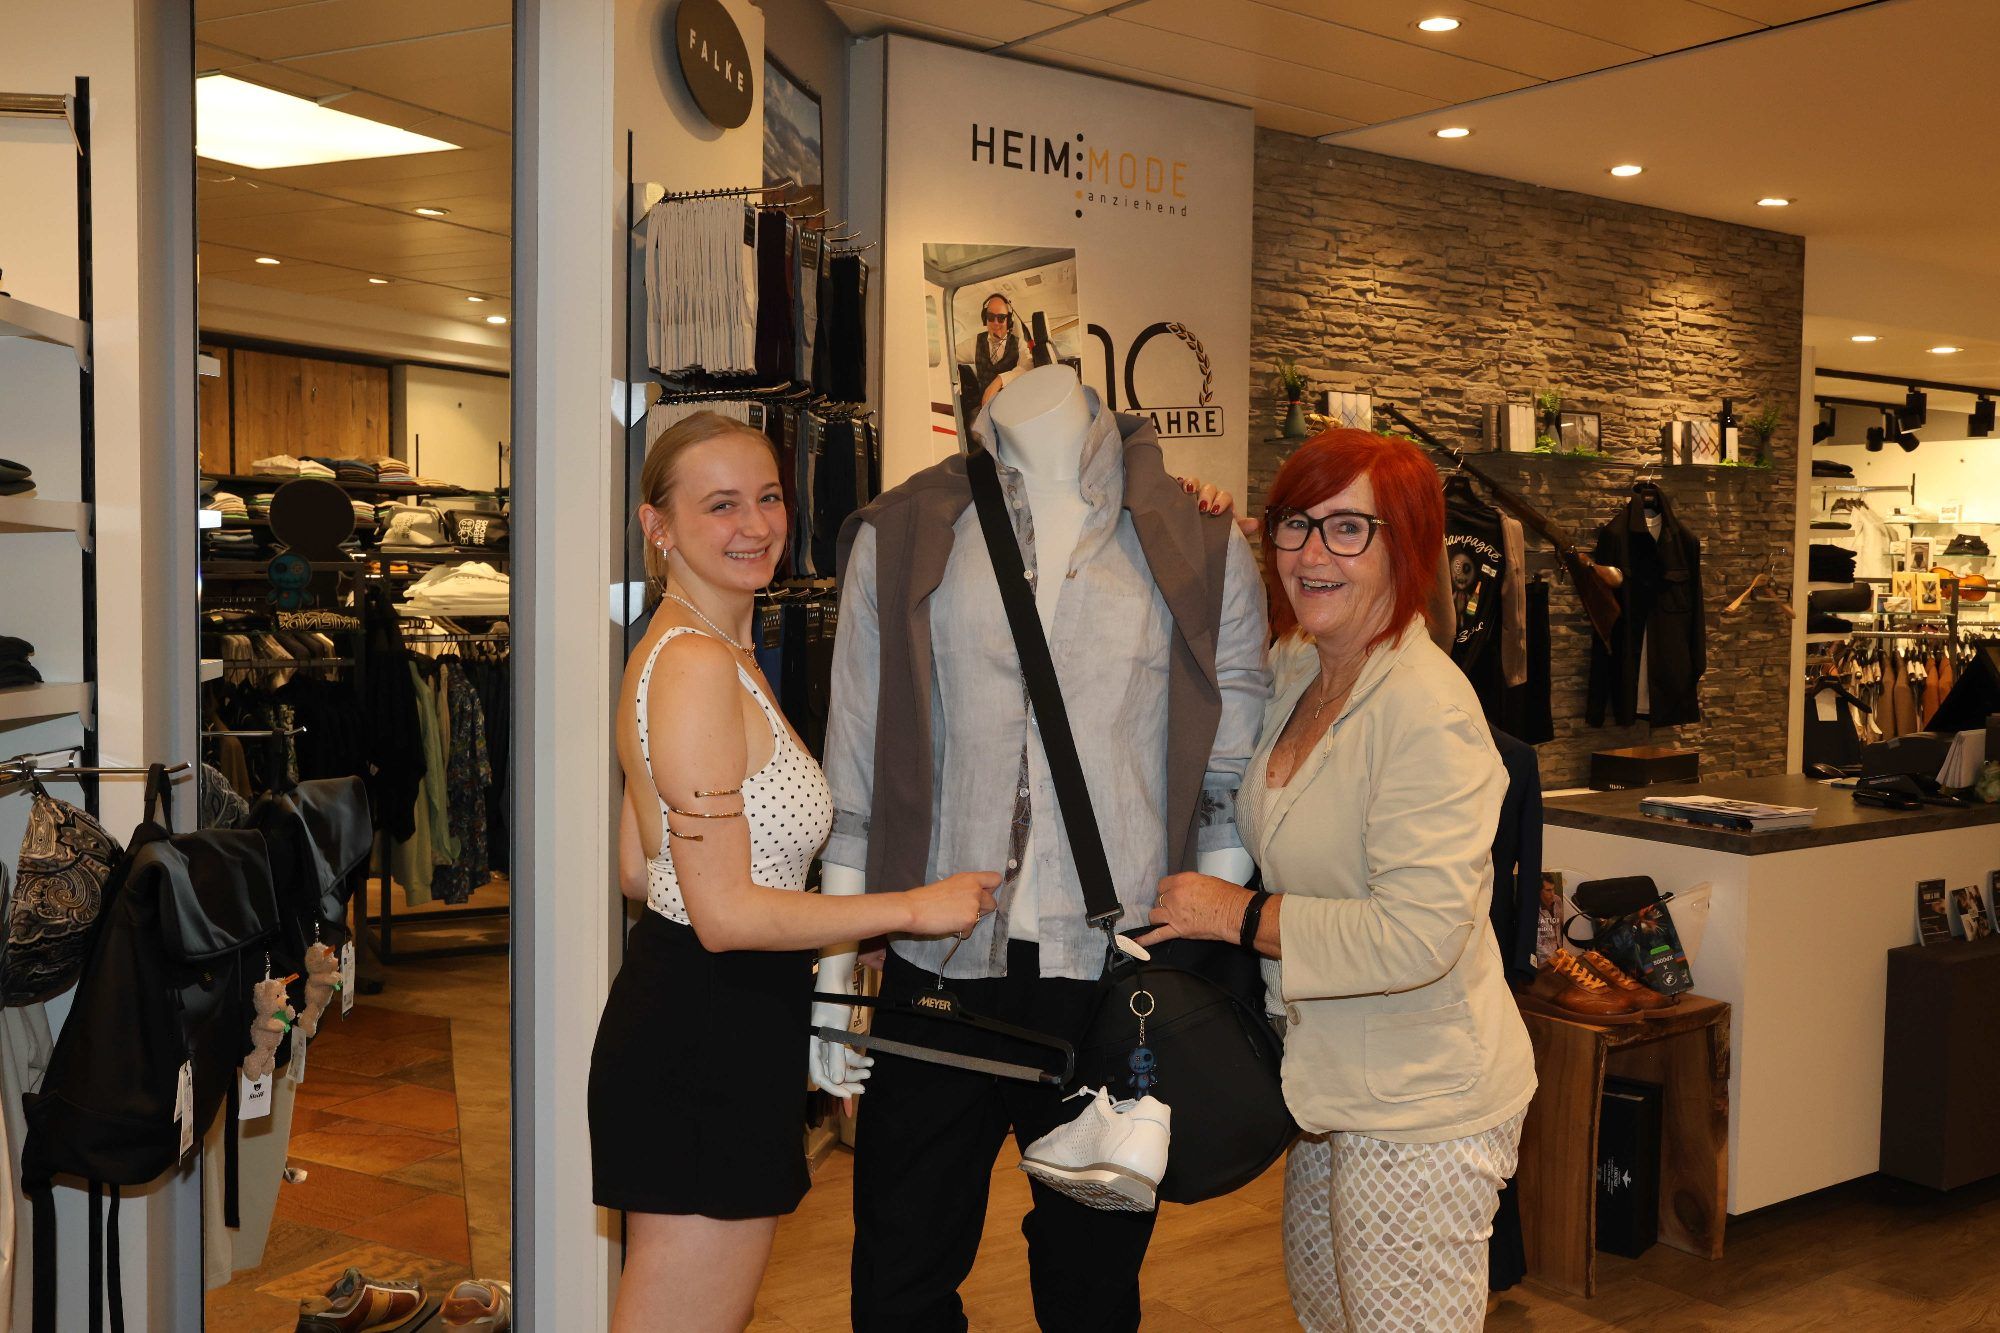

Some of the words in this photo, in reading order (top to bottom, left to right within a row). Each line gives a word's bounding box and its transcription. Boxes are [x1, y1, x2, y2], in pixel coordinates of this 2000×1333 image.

[688, 28, 744, 92] FALKE
[971, 123, 1070, 178] HEIM
[1087, 146, 1188, 199] MODE
[1087, 192, 1188, 217] anziehend
[1136, 410, 1217, 434] AHRE
[1443, 533, 1501, 563] hampagne
[917, 996, 952, 1012] MEYER
